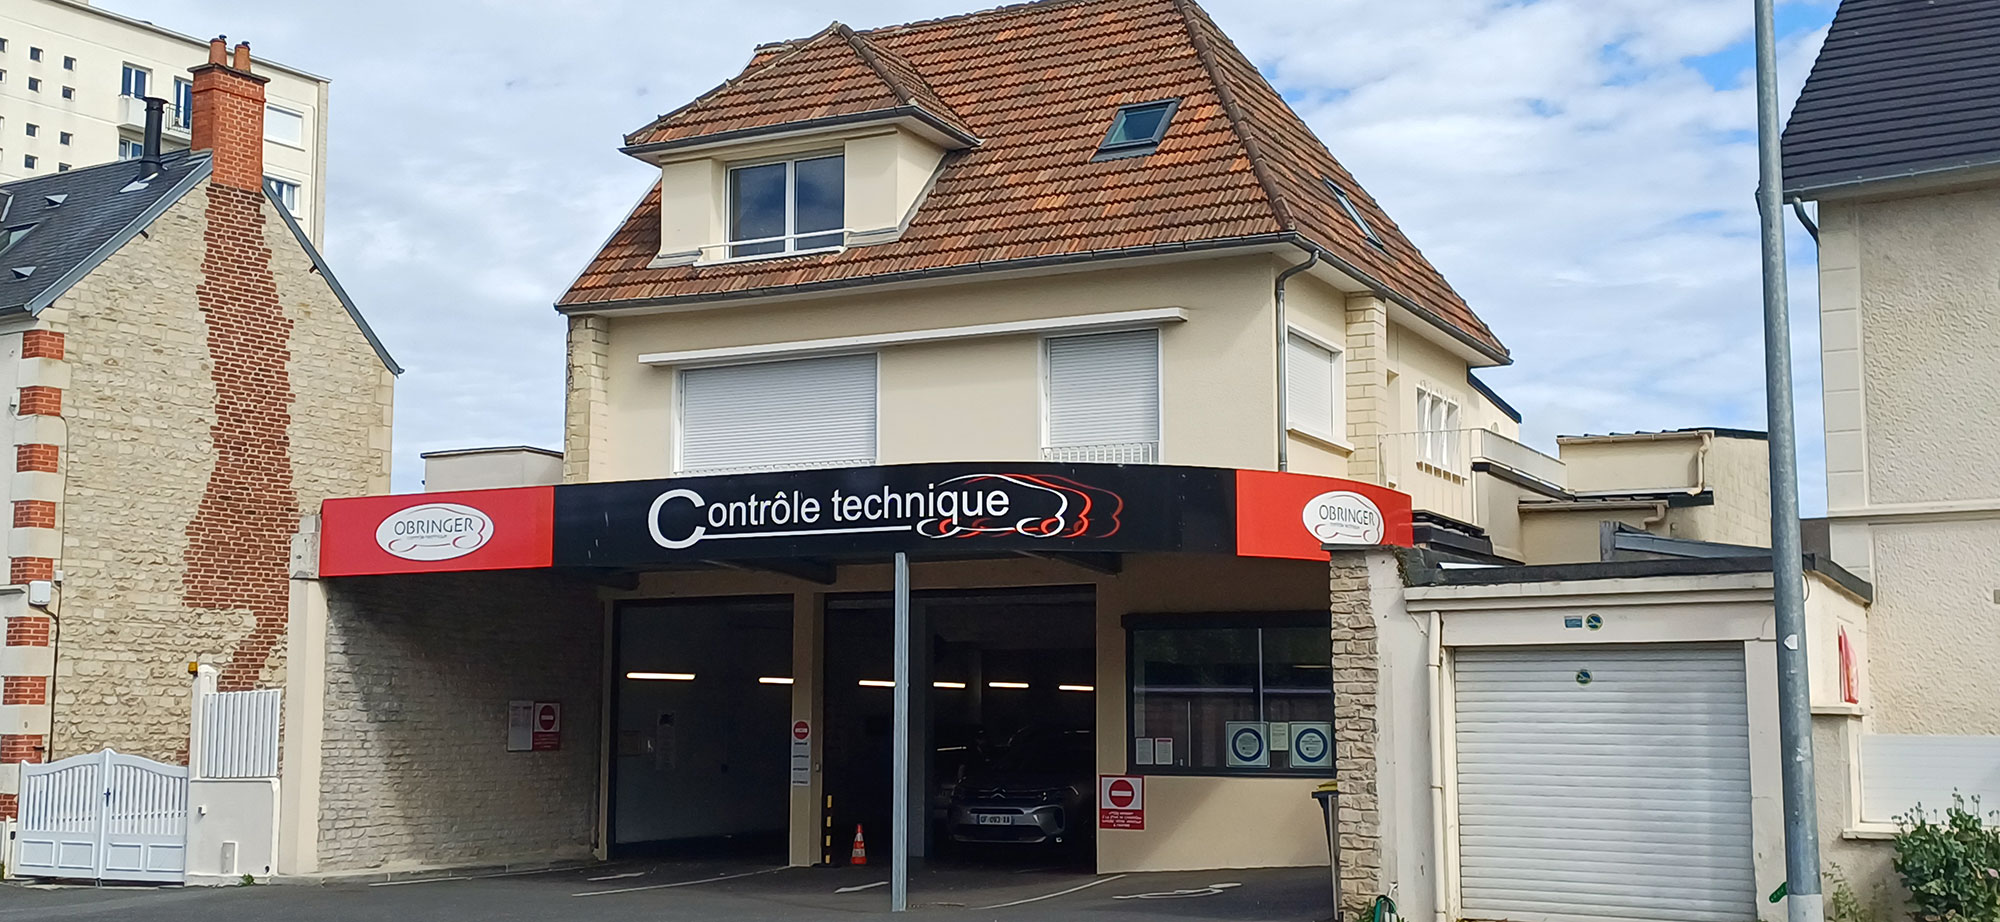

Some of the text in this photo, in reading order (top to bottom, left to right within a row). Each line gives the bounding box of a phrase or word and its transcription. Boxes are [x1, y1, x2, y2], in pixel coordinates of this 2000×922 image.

[394, 517, 474, 536] OBRINGER
[648, 484, 1010, 549] Contrôle technique
[1318, 504, 1376, 527] OBRINGER
